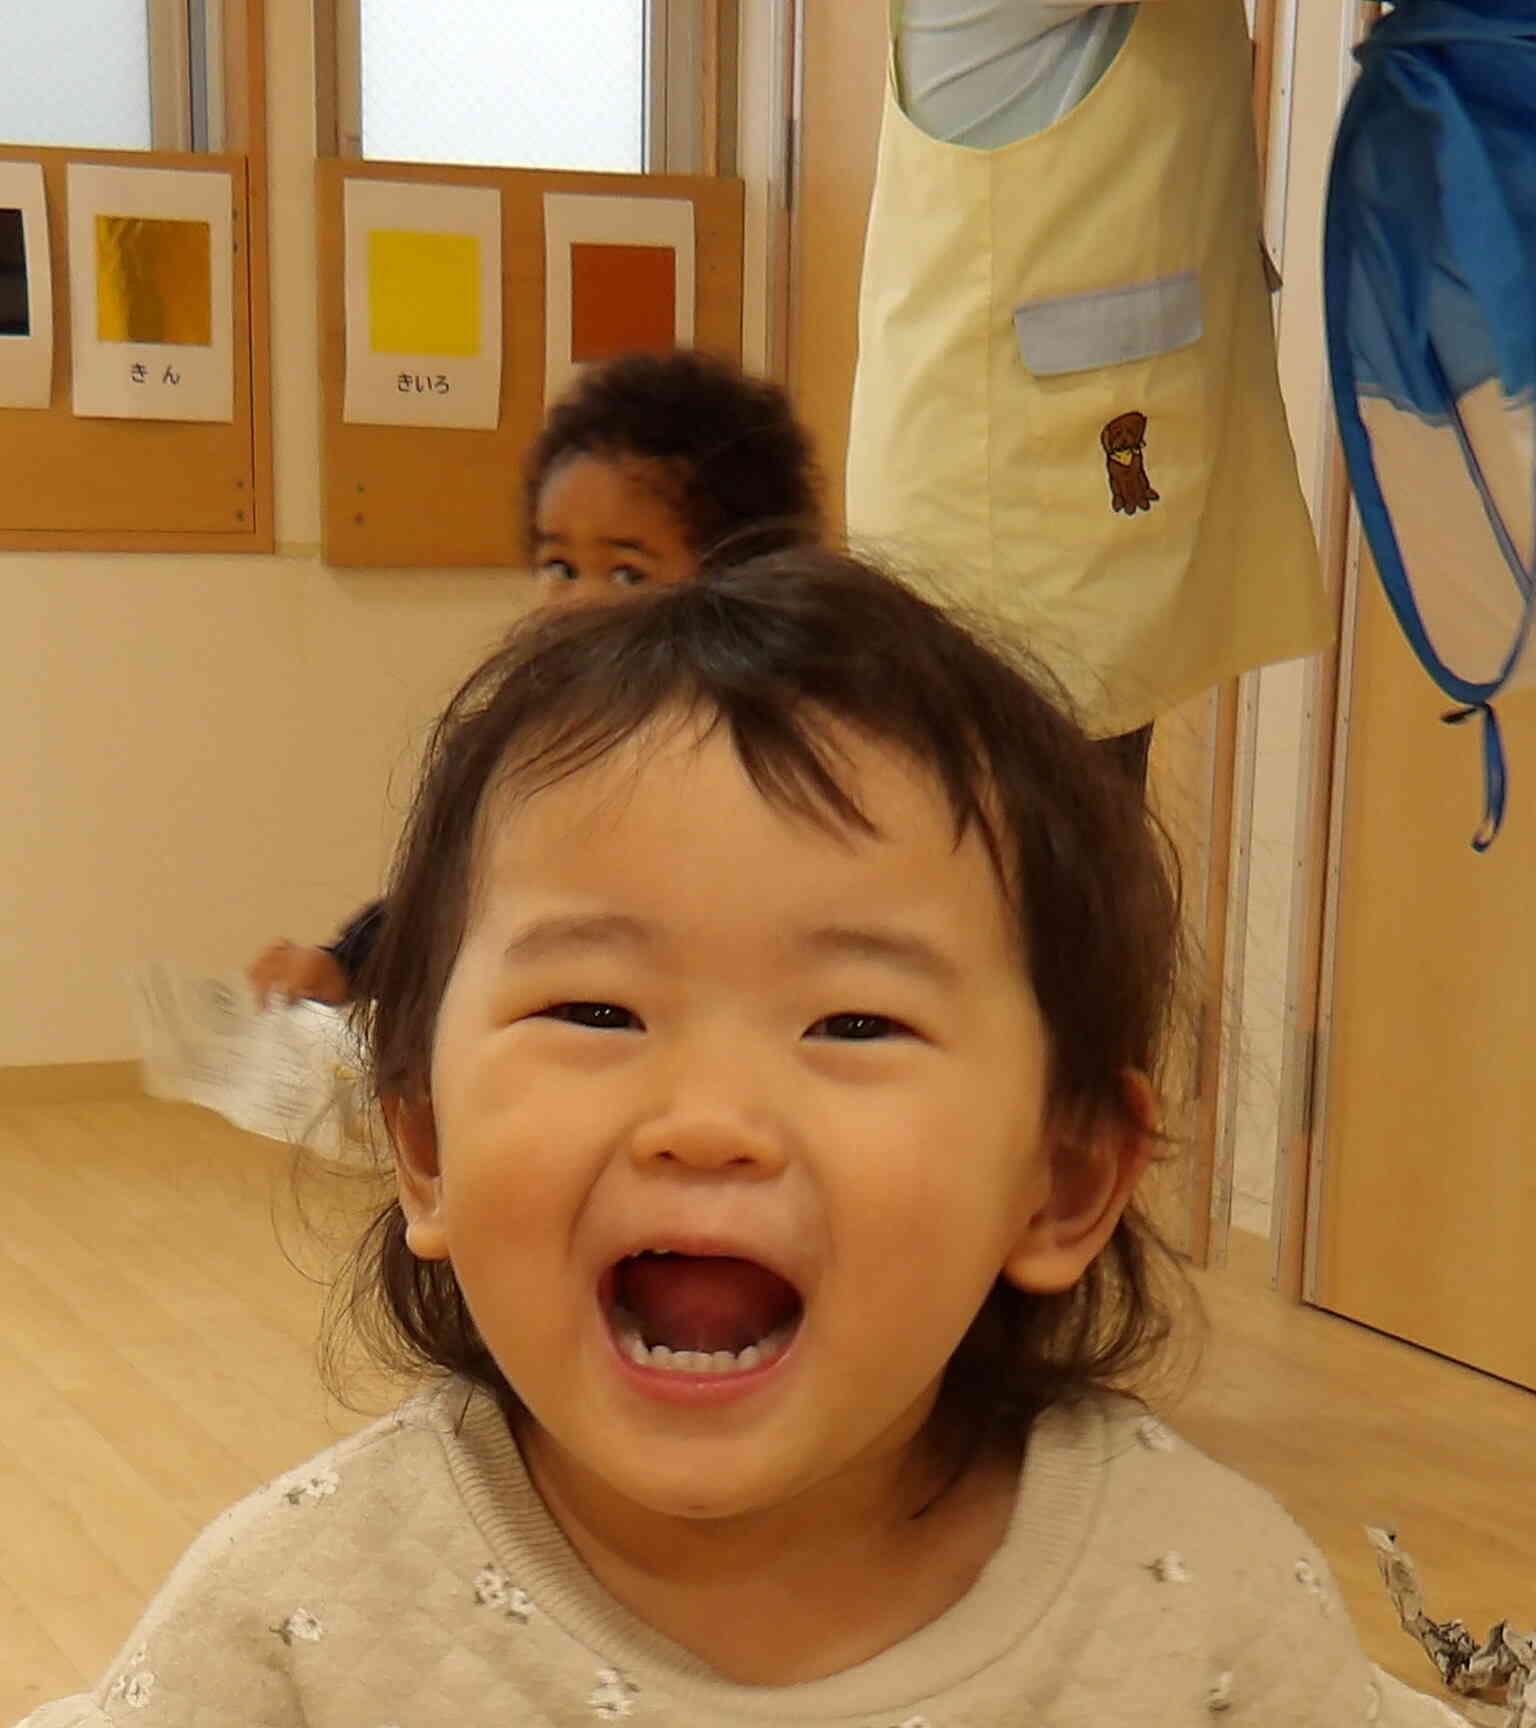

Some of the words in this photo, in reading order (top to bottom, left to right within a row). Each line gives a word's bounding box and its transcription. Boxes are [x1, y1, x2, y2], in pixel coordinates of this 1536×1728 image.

[129, 361, 181, 386] きん
[396, 372, 450, 395] きいろ
